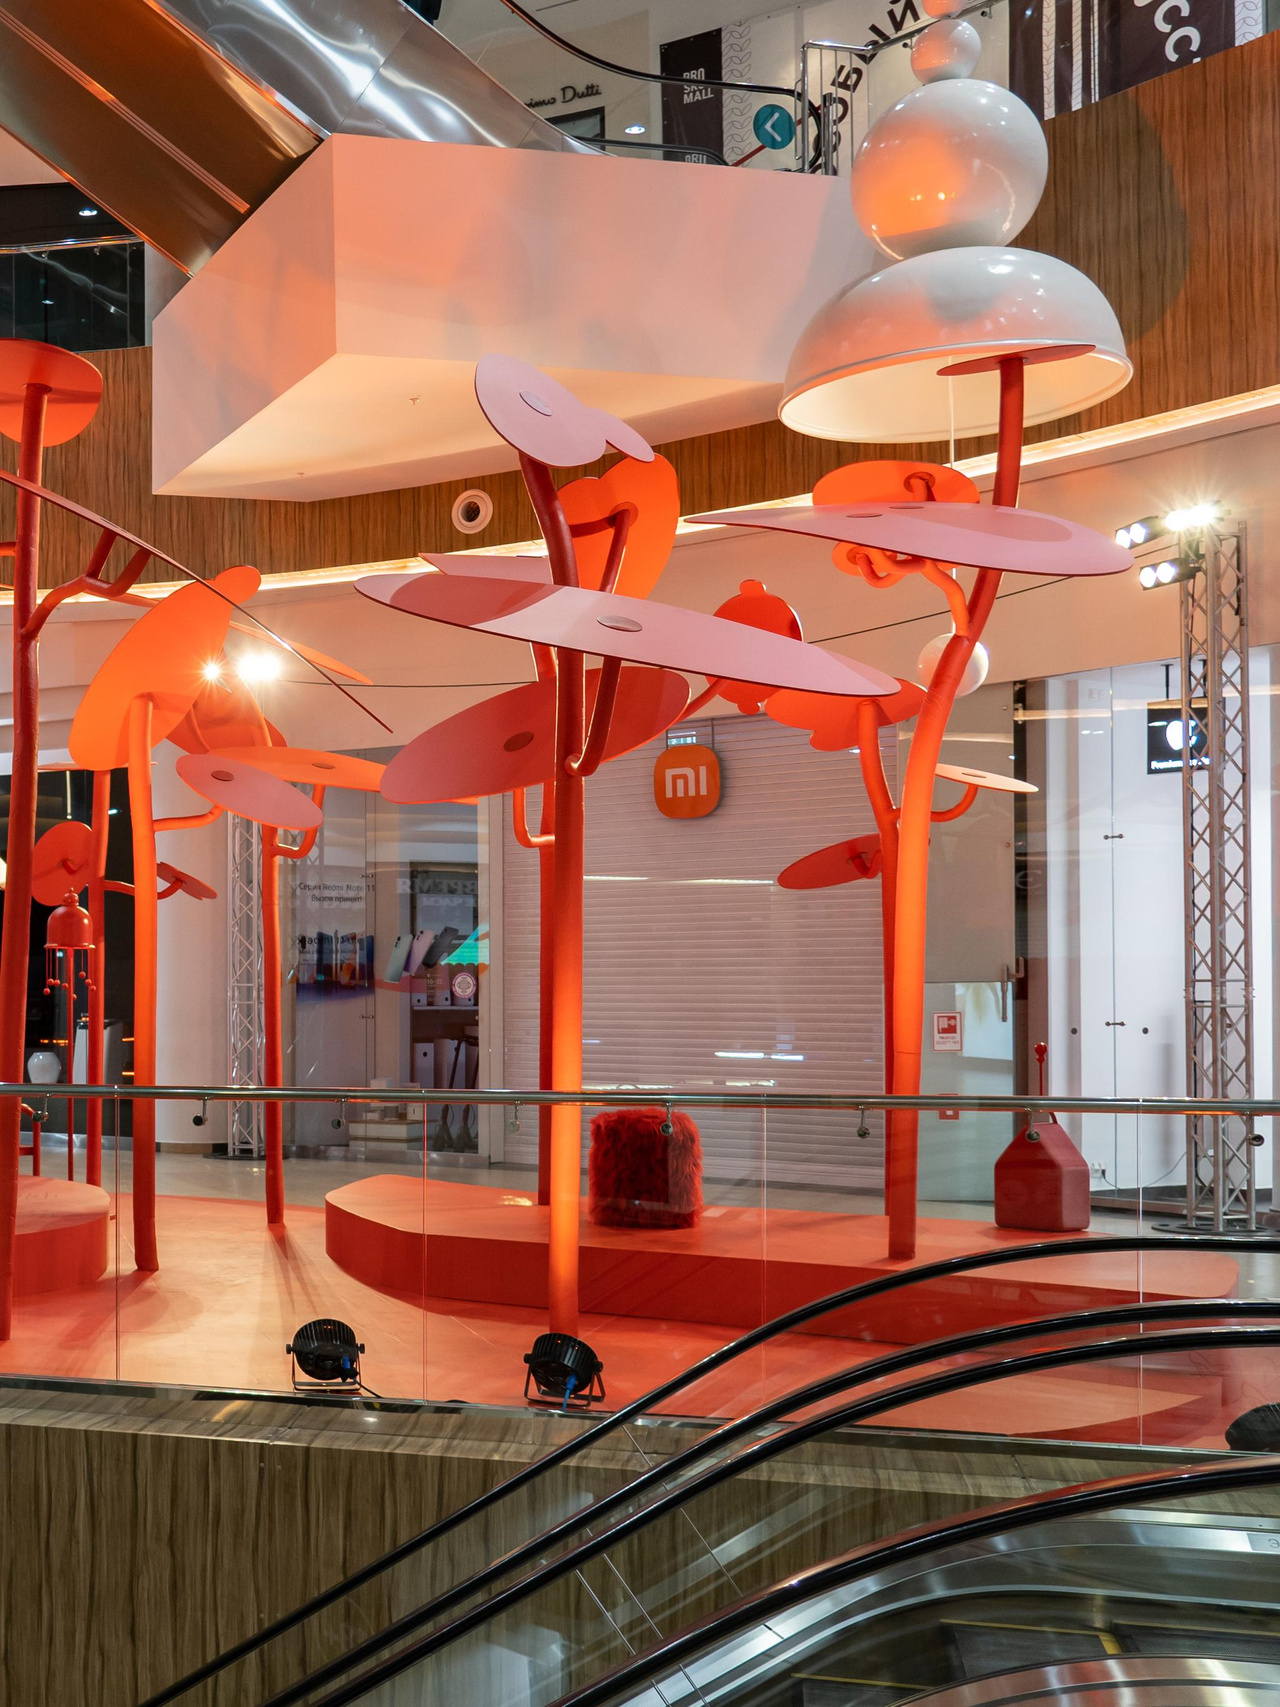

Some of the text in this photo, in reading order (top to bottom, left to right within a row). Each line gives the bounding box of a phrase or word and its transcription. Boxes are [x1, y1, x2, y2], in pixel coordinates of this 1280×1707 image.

[560, 82, 602, 103] Dutti
[683, 87, 715, 104] MALL
[298, 882, 321, 891] Серия
[323, 883, 344, 891] Redmi
[346, 884, 364, 892] Note
